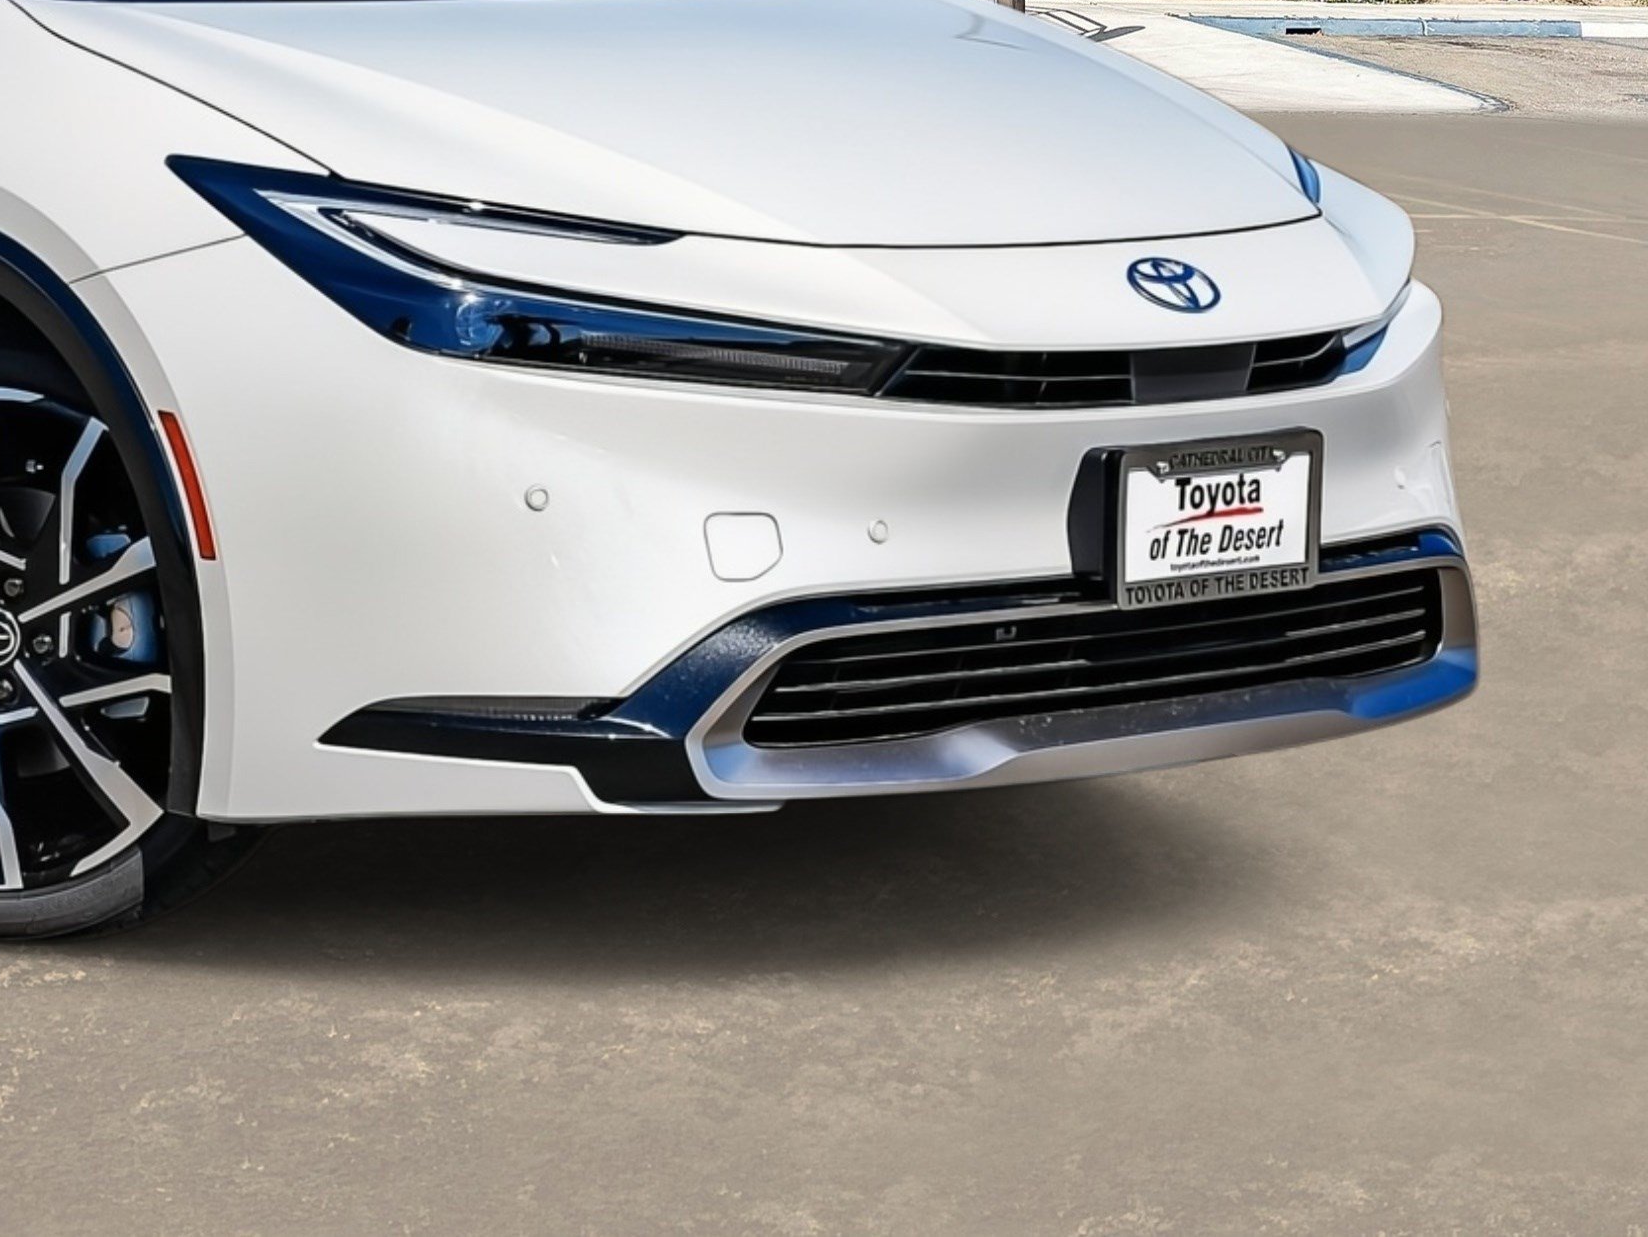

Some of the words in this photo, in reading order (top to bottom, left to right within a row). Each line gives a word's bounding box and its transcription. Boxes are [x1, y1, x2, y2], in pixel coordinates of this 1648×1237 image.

[1175, 473, 1261, 514] Toyota
[1149, 529, 1169, 561] of
[1175, 528, 1212, 557] The
[1218, 519, 1284, 553] Desert
[1125, 582, 1185, 606] TOYOTA
[1190, 579, 1209, 597] OF
[1215, 573, 1245, 595] THE
[1249, 566, 1310, 590] DESERT
